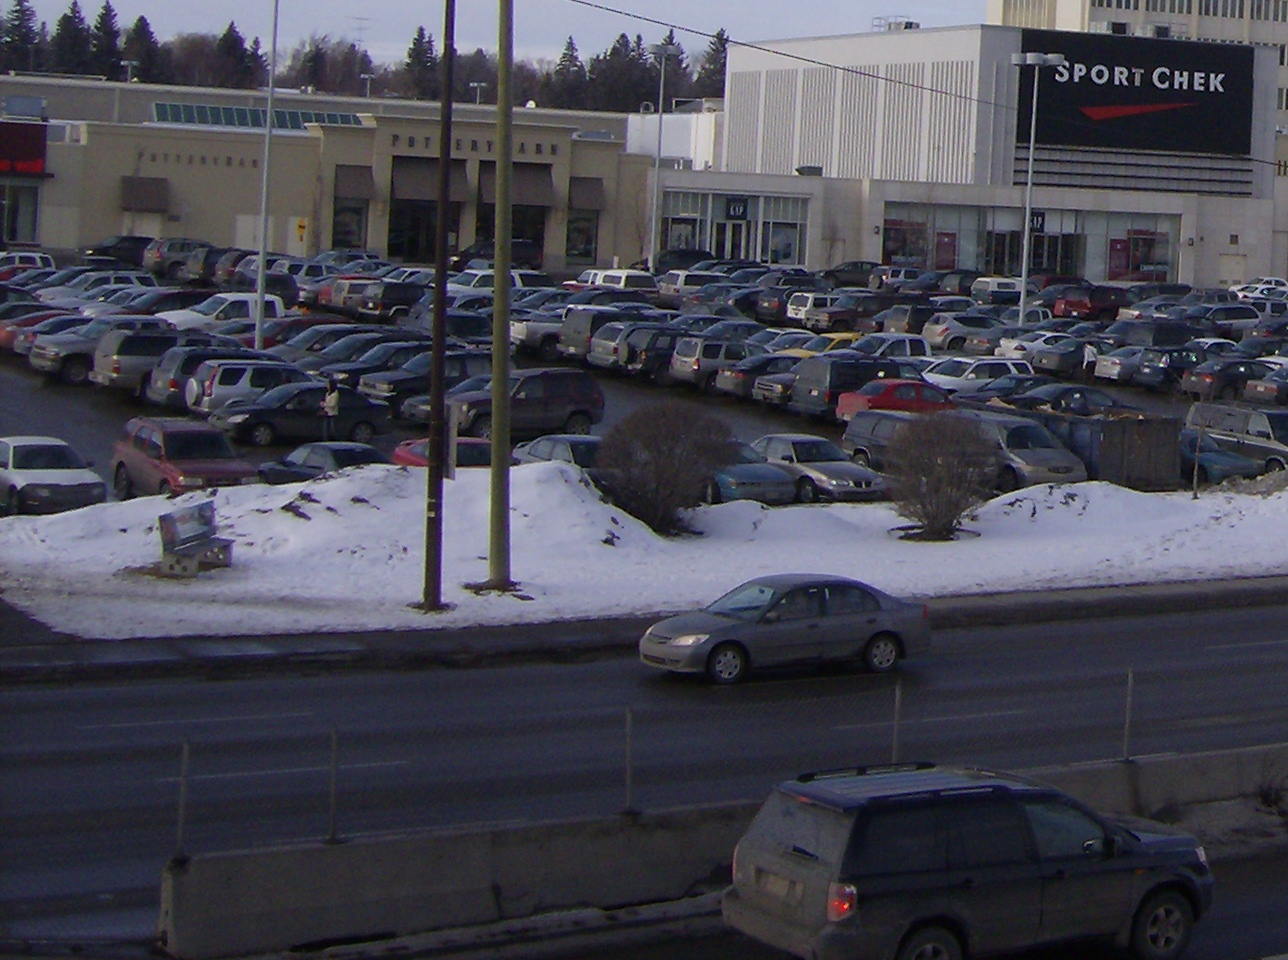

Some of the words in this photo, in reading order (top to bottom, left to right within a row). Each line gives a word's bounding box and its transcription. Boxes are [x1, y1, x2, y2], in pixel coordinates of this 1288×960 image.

[1054, 60, 1145, 87] SPORT
[1152, 66, 1226, 93] CHEK
[391, 134, 494, 153] POTERY
[517, 142, 559, 156] ARN
